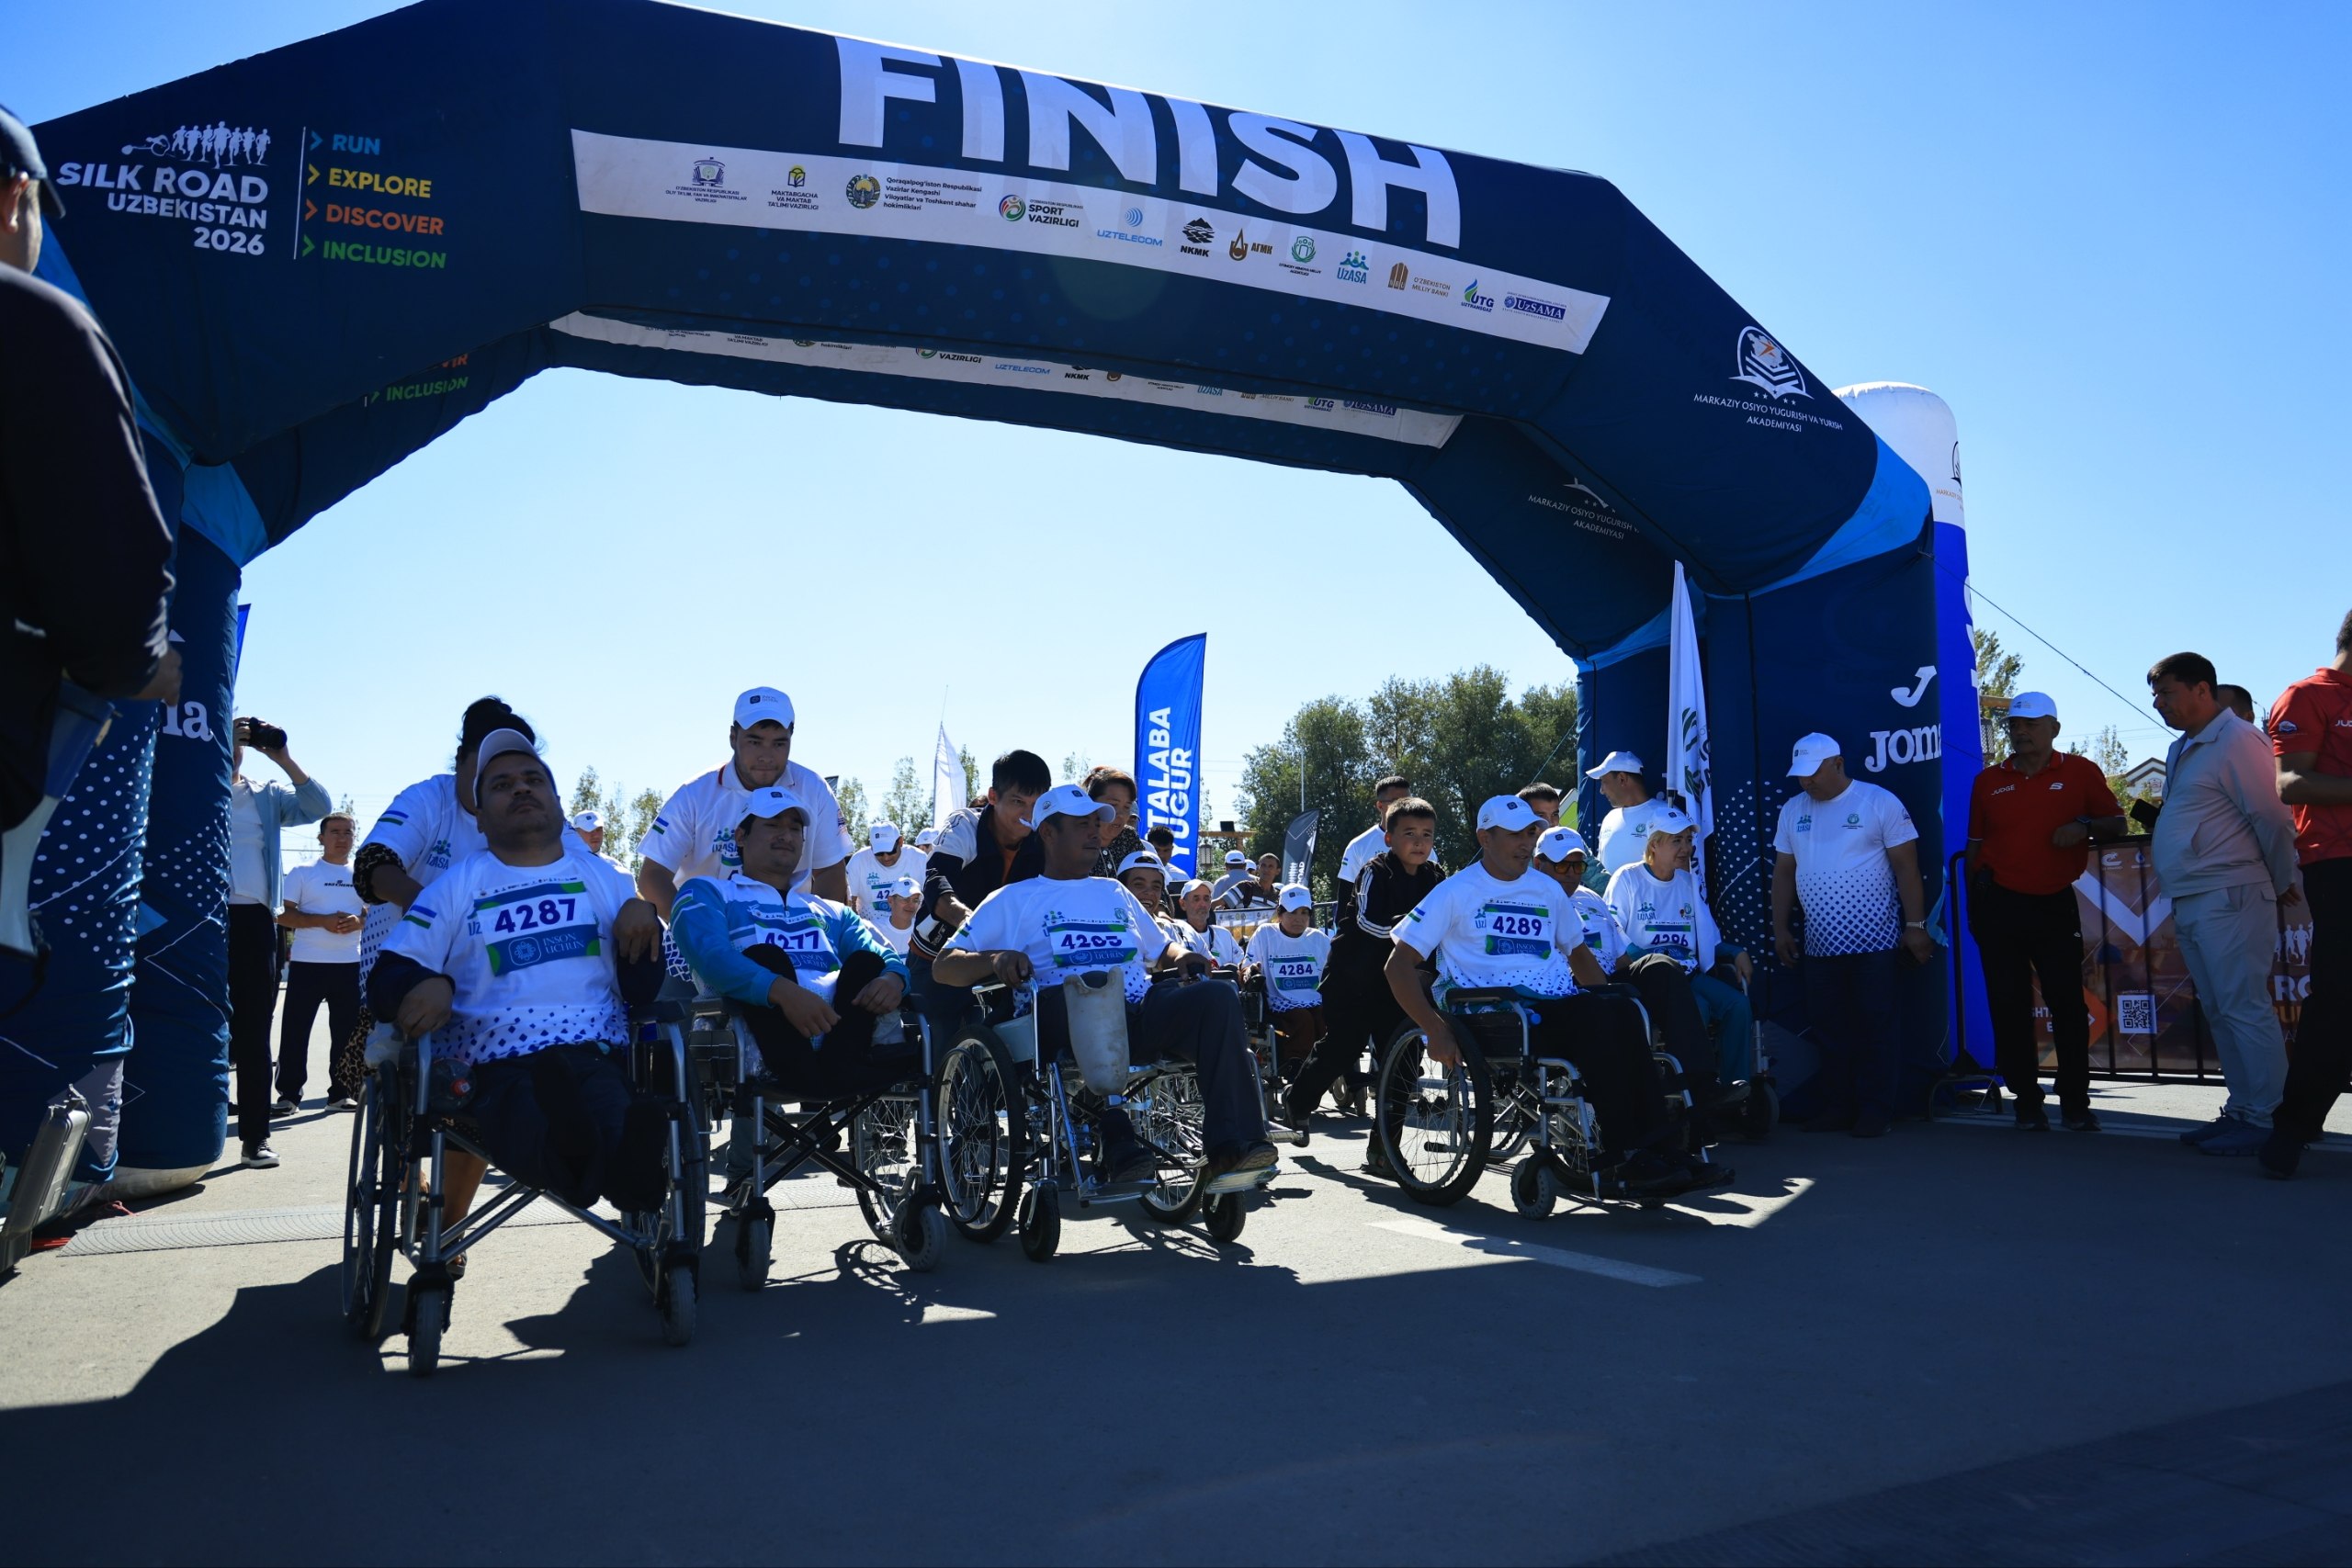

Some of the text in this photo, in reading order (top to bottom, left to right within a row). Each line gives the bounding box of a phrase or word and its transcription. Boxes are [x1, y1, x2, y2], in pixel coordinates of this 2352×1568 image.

[332, 133, 380, 155] RUN
[834, 35, 1461, 249] FINISH
[56, 162, 269, 204] SILK ROAD
[328, 168, 432, 198] EXPLORE
[885, 185, 941, 197] Vazirlar Kengashi
[942, 183, 982, 193] Respublikasi
[771, 190, 819, 198] MAKTABGACHA
[884, 194, 915, 204] Viloyatlar
[924, 197, 954, 207] Toshkent
[955, 200, 977, 209] shahar
[107, 193, 267, 229] UZBEKISTAN
[883, 201, 922, 211] hokimliklari
[1028, 204, 1065, 216] SPORT
[325, 203, 445, 235] DISCOVER
[1028, 214, 1080, 228] VAZIRLIGI
[193, 226, 266, 256] 2026
[1097, 229, 1163, 247] UZTELECOM
[322, 240, 447, 269] INCLUSION
[1180, 244, 1209, 257] NKMK
[1411, 284, 1431, 294] MILLIY
[1431, 288, 1449, 298] BANKI
[1414, 276, 1451, 291] O'ZBEKISTON
[1461, 301, 1493, 313] UZTRANSGAZ
[1470, 291, 1495, 308] UTG
[1517, 299, 1563, 319] UzSAMA
[939, 353, 982, 364] VAZIRLIGI
[995, 363, 1051, 376] UZTELECOM
[1064, 372, 1090, 381] NKMK
[386, 377, 469, 401] INCLUSION
[1313, 398, 1335, 409] UTG
[1693, 393, 1843, 431] MARKAZIY OSIYO YUGURISH VA YURISH
[1747, 415, 1802, 433] AKADEMIYASI
[1528, 494, 1570, 512] MARKAZIY
[1571, 506, 1596, 519] OSIYO
[1596, 513, 1634, 530] YUGURISH
[1573, 519, 1624, 540] AKADEMIYASI
[1991, 784, 2016, 795] JUDGE
[1170, 747, 1193, 858] YUGUR
[494, 897, 576, 933] 4287
[1492, 915, 1543, 937] 4289
[542, 932, 577, 948] INSON
[765, 930, 820, 950] 4277
[1278, 964, 1314, 976] 4284
